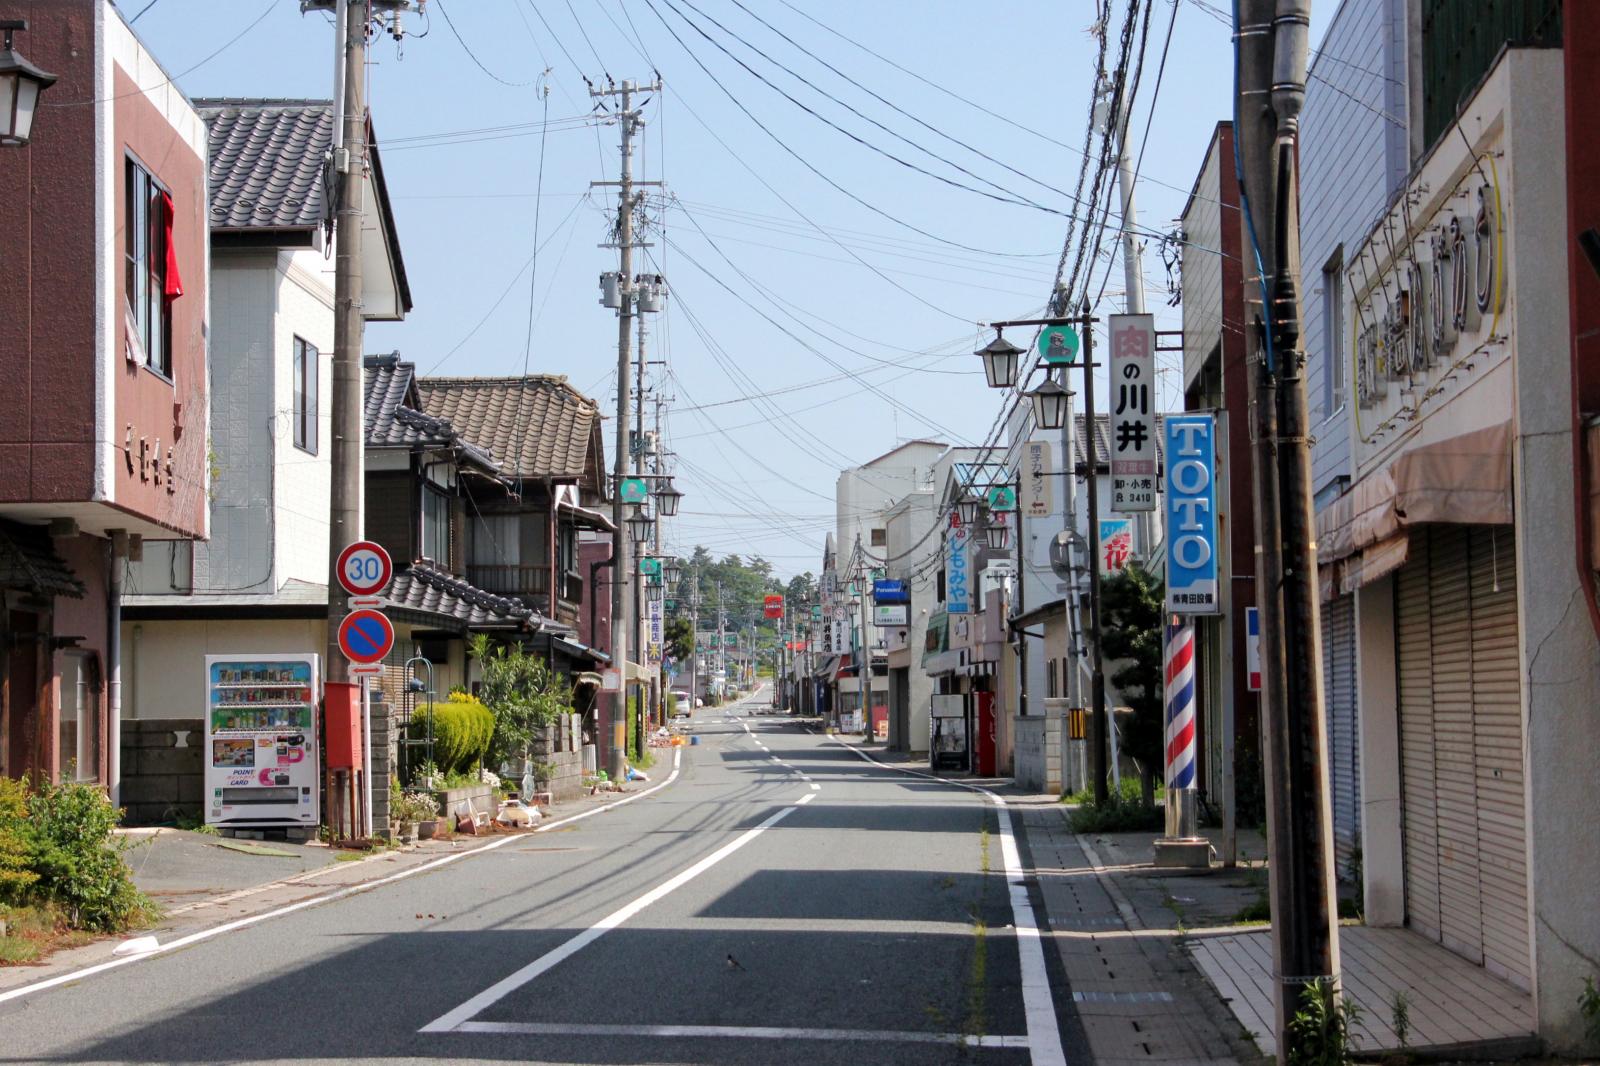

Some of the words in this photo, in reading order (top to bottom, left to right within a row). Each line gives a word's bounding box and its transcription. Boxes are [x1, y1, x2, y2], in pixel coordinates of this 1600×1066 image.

[1114, 325, 1149, 451] 肉の川井
[1171, 423, 1212, 569] TOTO
[350, 557, 379, 580] 30
